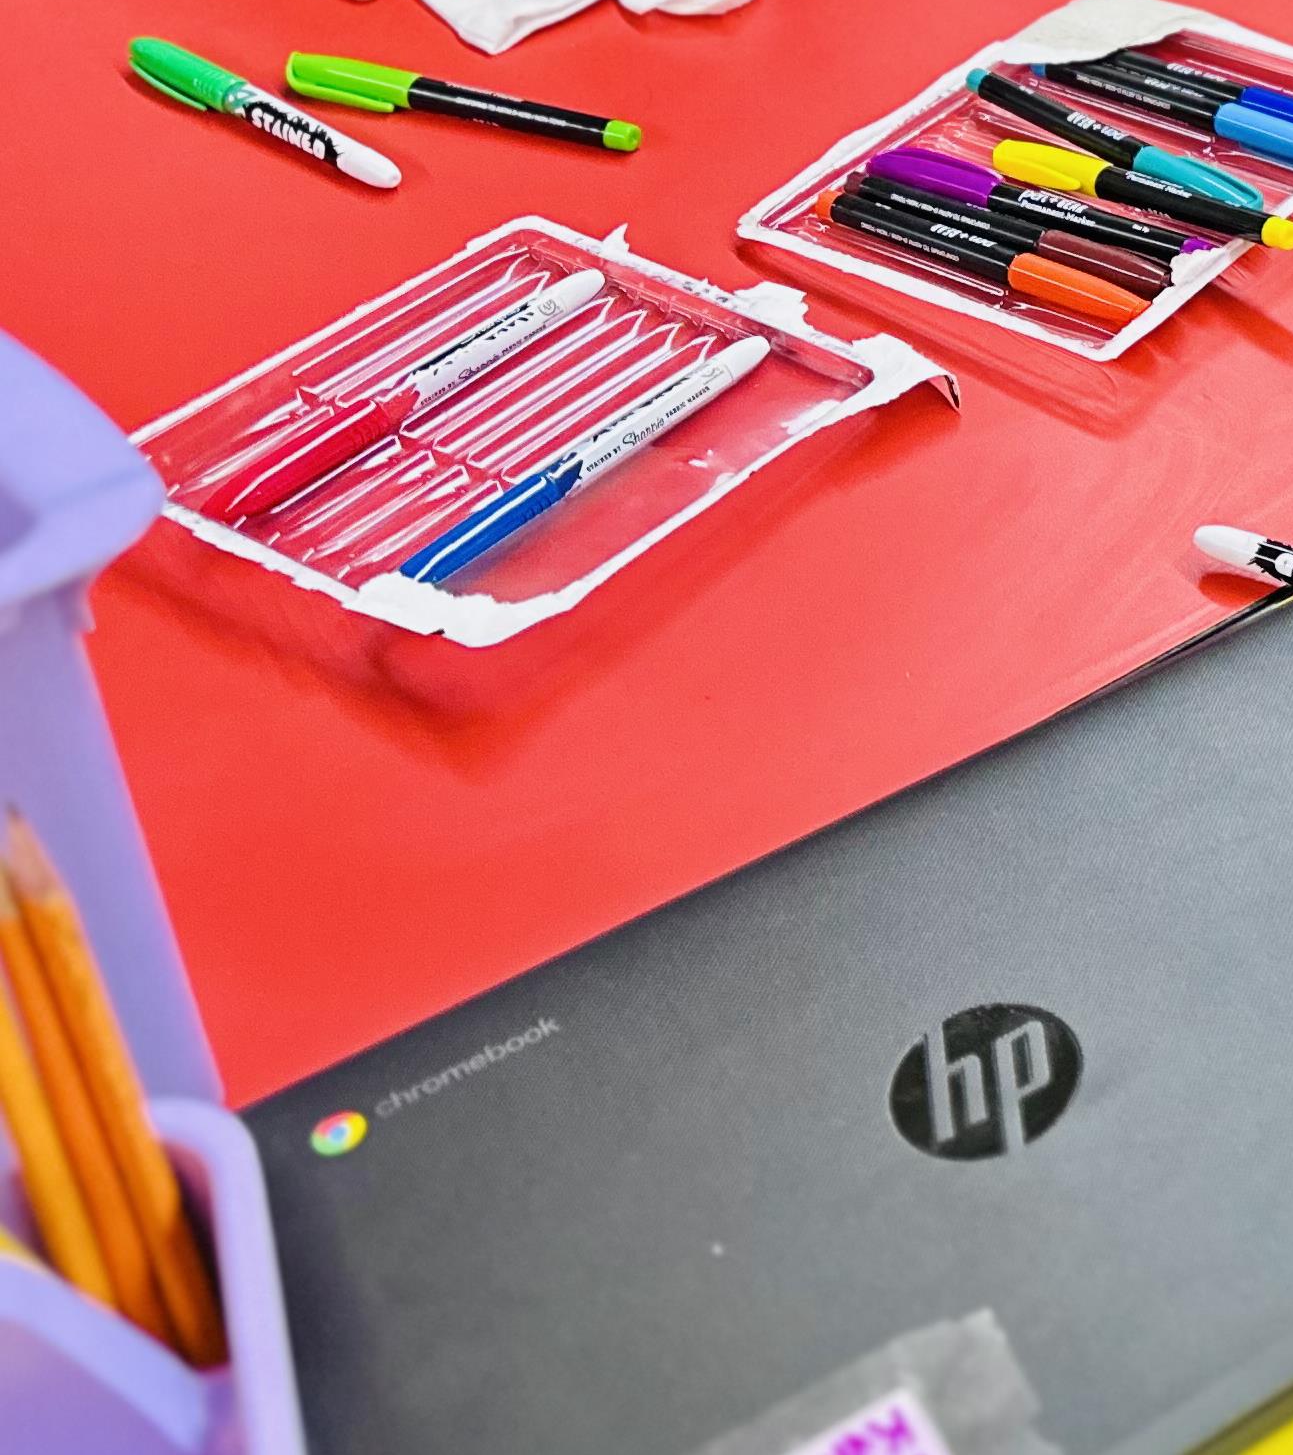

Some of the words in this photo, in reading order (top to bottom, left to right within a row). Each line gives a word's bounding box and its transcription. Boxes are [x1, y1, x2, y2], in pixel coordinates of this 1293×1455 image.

[251, 107, 326, 160] STAINED
[374, 1017, 560, 1119] chromebook
[926, 1016, 1052, 1158] hp
